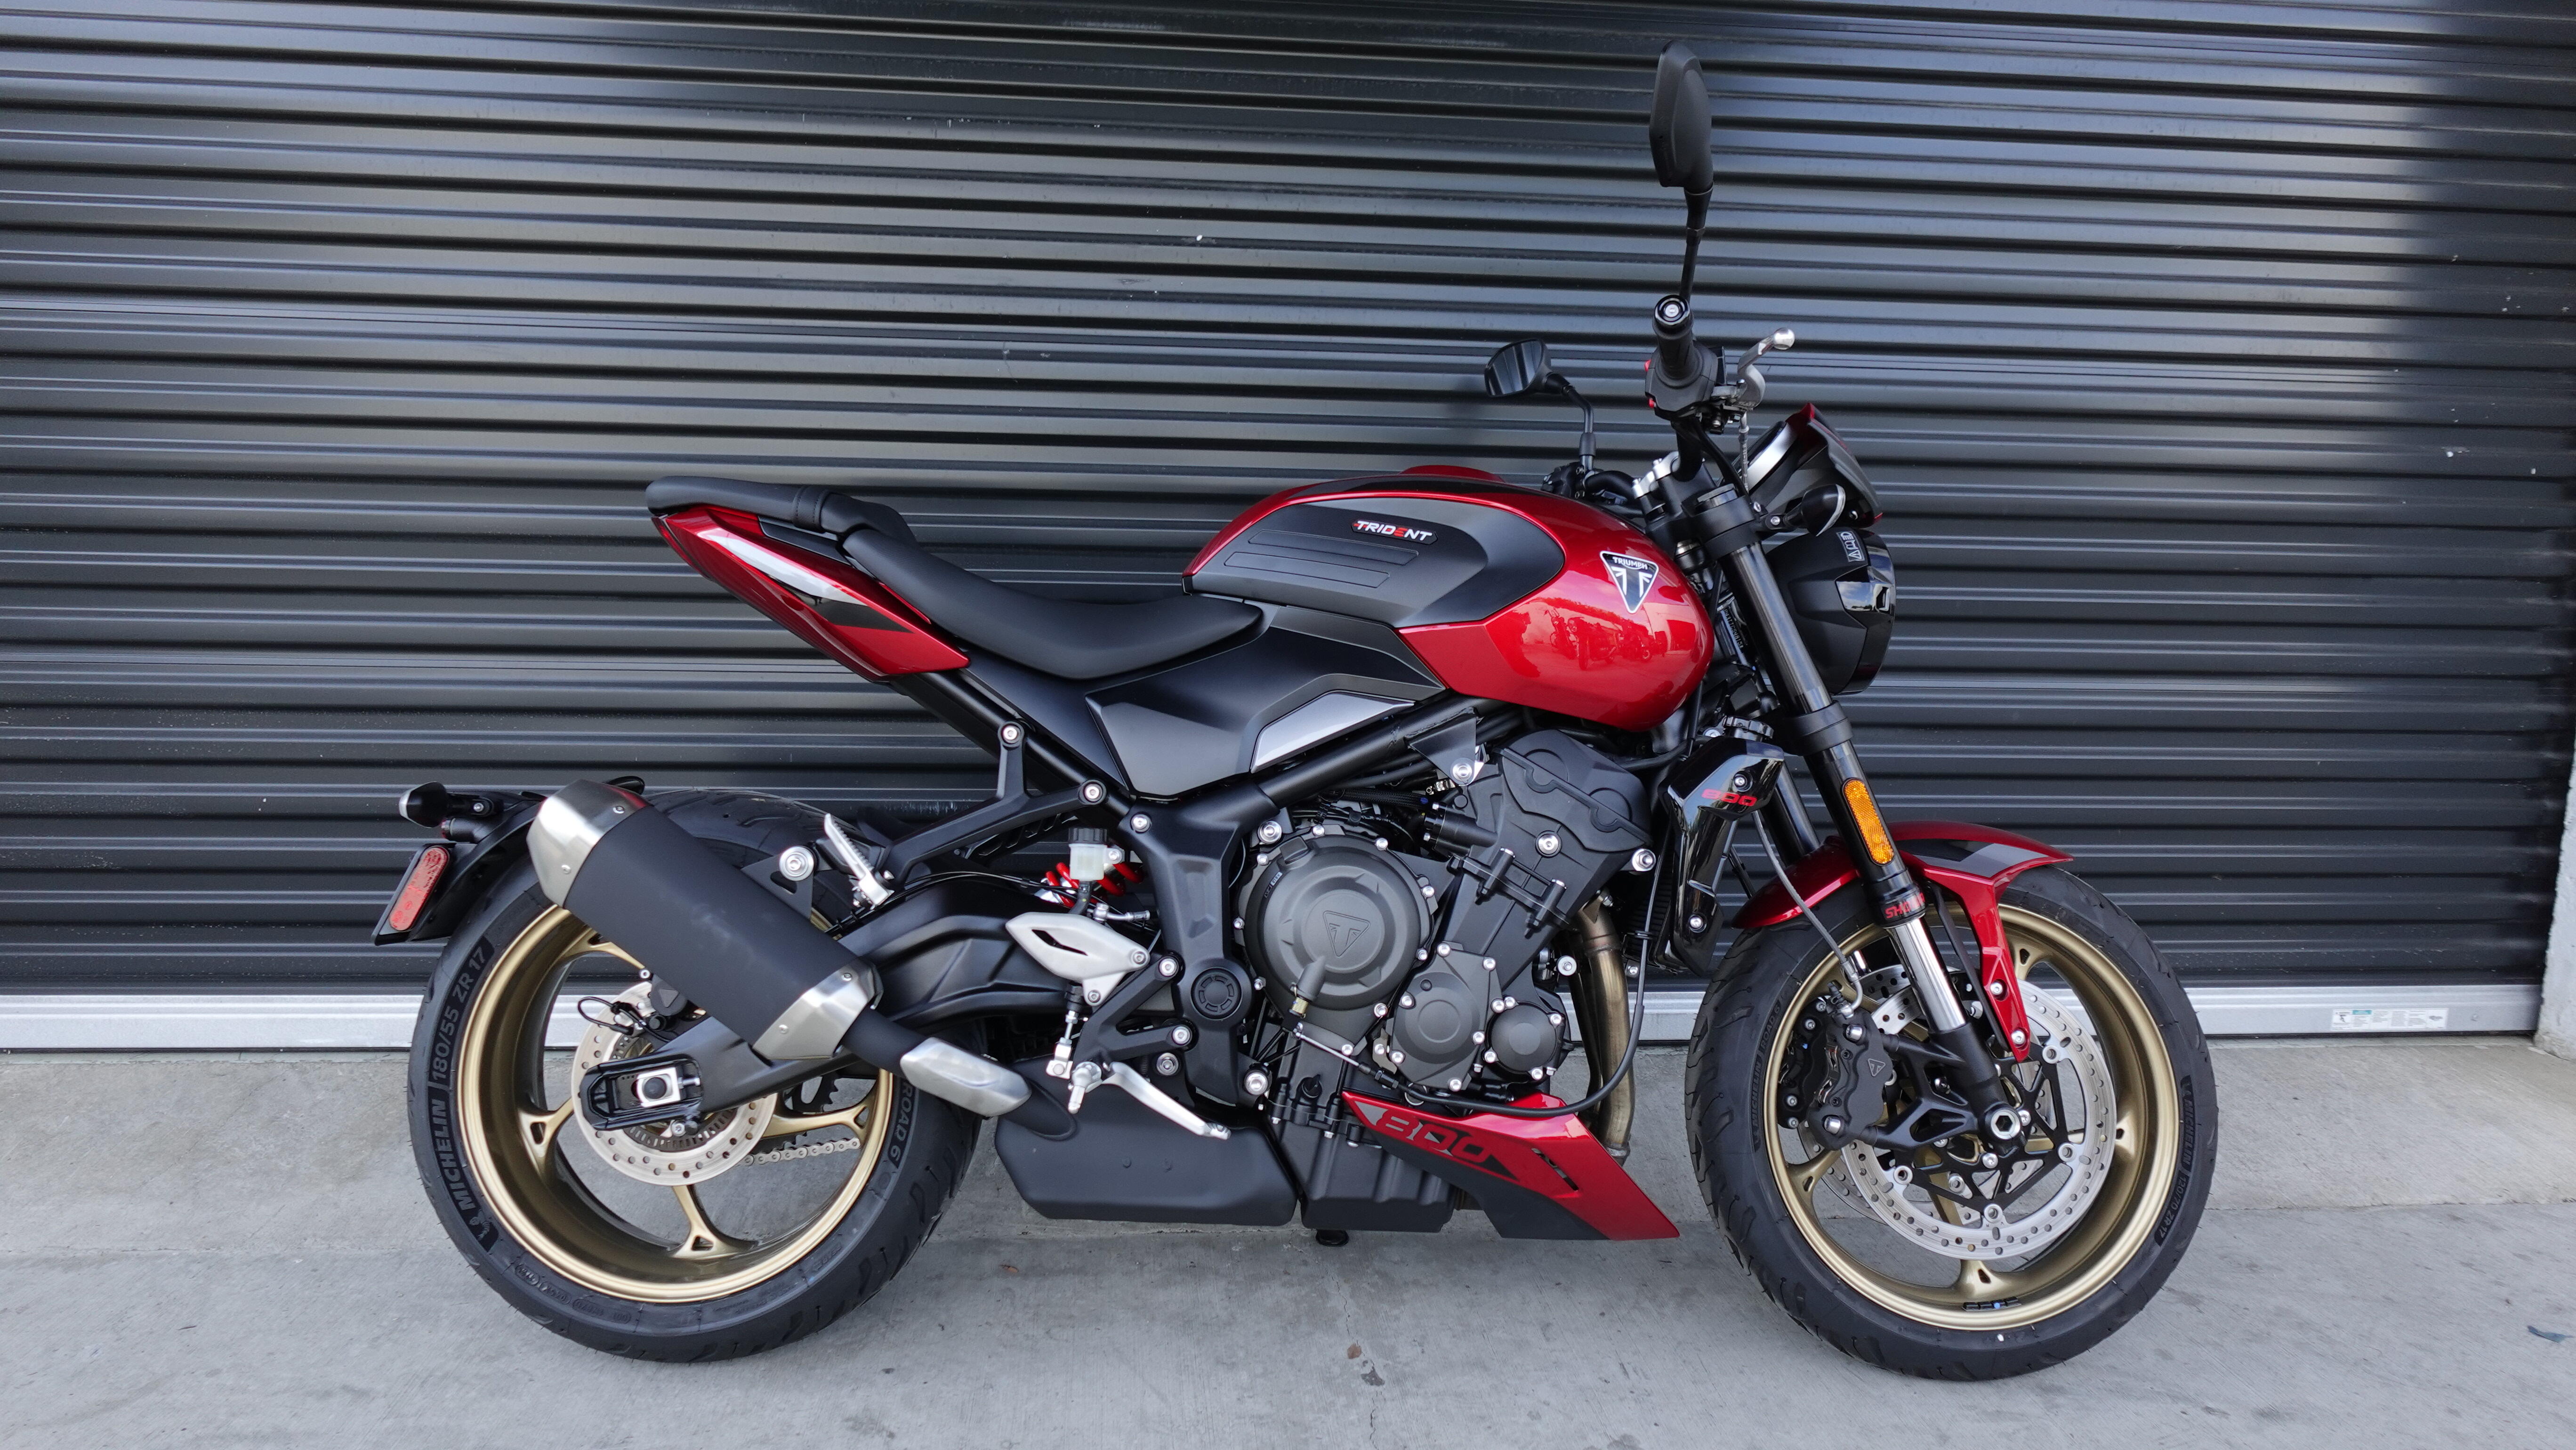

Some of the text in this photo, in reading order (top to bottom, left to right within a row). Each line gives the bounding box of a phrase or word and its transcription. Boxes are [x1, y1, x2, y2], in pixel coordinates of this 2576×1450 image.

[1357, 520, 1433, 541] TRIDENT
[1612, 556, 1648, 570] TRIUMPH
[1701, 788, 1758, 806] 800
[1760, 1017, 1775, 1048] ROAD
[431, 946, 486, 1211] MICHELIN 180/55 ZR 17
[890, 1081, 913, 1161] ROAD 6
[1376, 1109, 1491, 1163] 800
[2171, 1176, 2187, 1210] 120/70
[2165, 1210, 2175, 1225] ZR
[2158, 1226, 2167, 1239] 17
